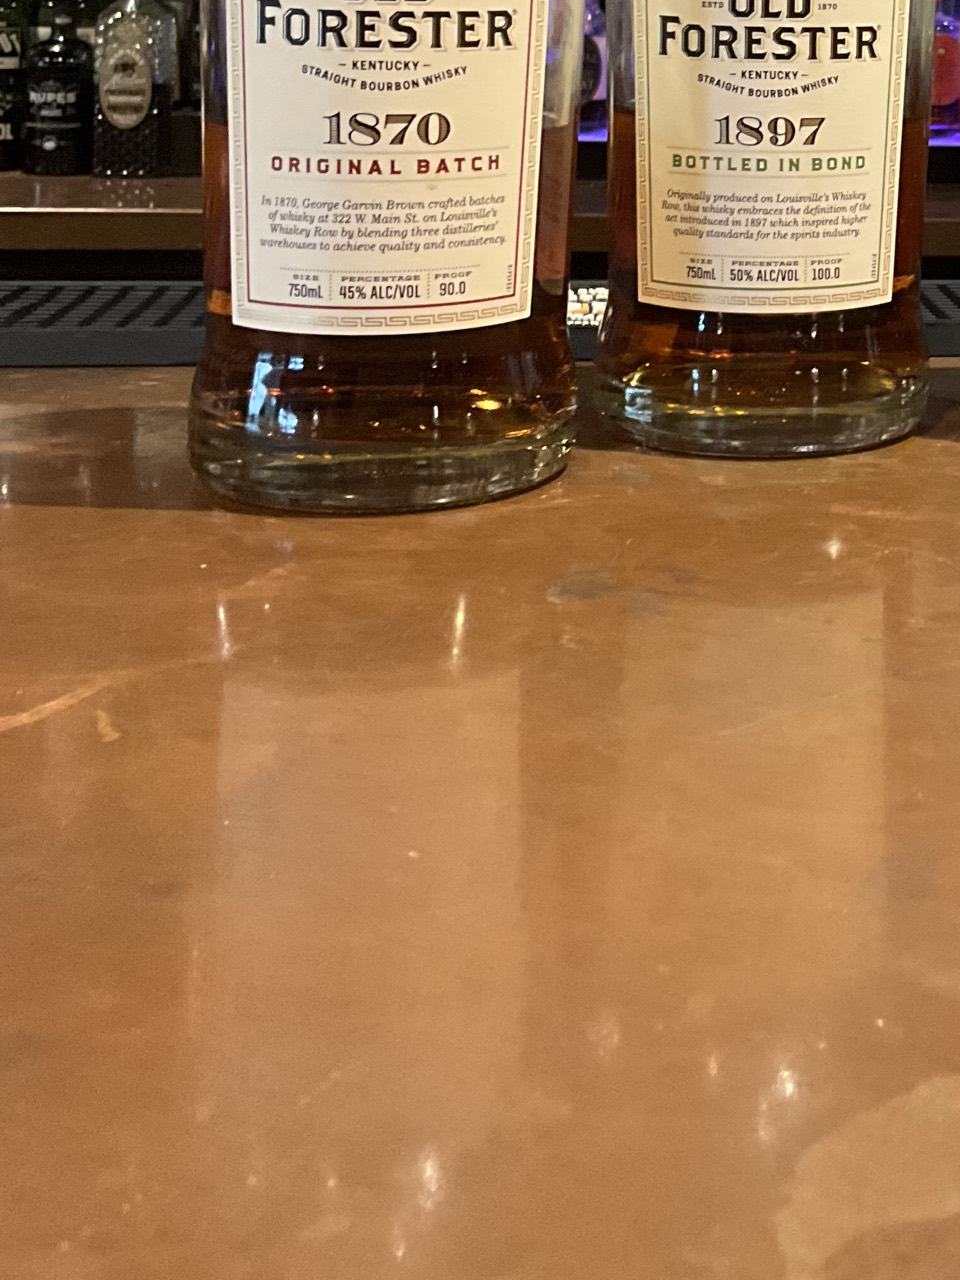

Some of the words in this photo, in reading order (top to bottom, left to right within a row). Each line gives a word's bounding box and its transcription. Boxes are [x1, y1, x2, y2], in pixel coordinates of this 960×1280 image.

[701, 1, 724, 9] ESTD
[658, 15, 878, 60] FORESTER
[352, 60, 420, 71] KENTUCKY
[301, 64, 356, 89] STRAIGHT
[360, 80, 420, 91] BOURBON
[423, 65, 468, 87] WHISKY
[741, 70, 799, 80] KENTUCKY
[697, 73, 745, 95] STRAIGHT
[748, 87, 799, 98] BOURBON
[801, 74, 840, 93] WHISKY
[322, 111, 451, 146] 1870
[714, 115, 826, 146] 1897
[271, 156, 402, 175] ORIGINAL
[416, 155, 500, 175] BATCH
[672, 154, 768, 172] BOTTLED
[779, 158, 800, 171] IN
[811, 155, 865, 171] BOND
[261, 195, 272, 207] In
[274, 196, 299, 209] 1870,
[302, 198, 340, 212] George
[342, 200, 383, 211] Garvin
[386, 199, 425, 210] Brown
[428, 196, 467, 211] crafted
[469, 194, 505, 207] batches
[667, 189, 711, 202] Originally
[713, 193, 758, 203] produced
[832, 191, 867, 201] Whiskey
[810, 258, 843, 266] PROOF
[434, 271, 473, 280] PROOF
[686, 266, 716, 280] 750mL
[730, 268, 753, 282] 50%
[757, 269, 800, 282] ALC/VOL
[812, 267, 840, 281] 100.0
[288, 283, 323, 299] 750mL
[339, 285, 366, 300] 45%
[370, 284, 421, 300] ALC/VOL
[439, 281, 466, 296] 90.0
